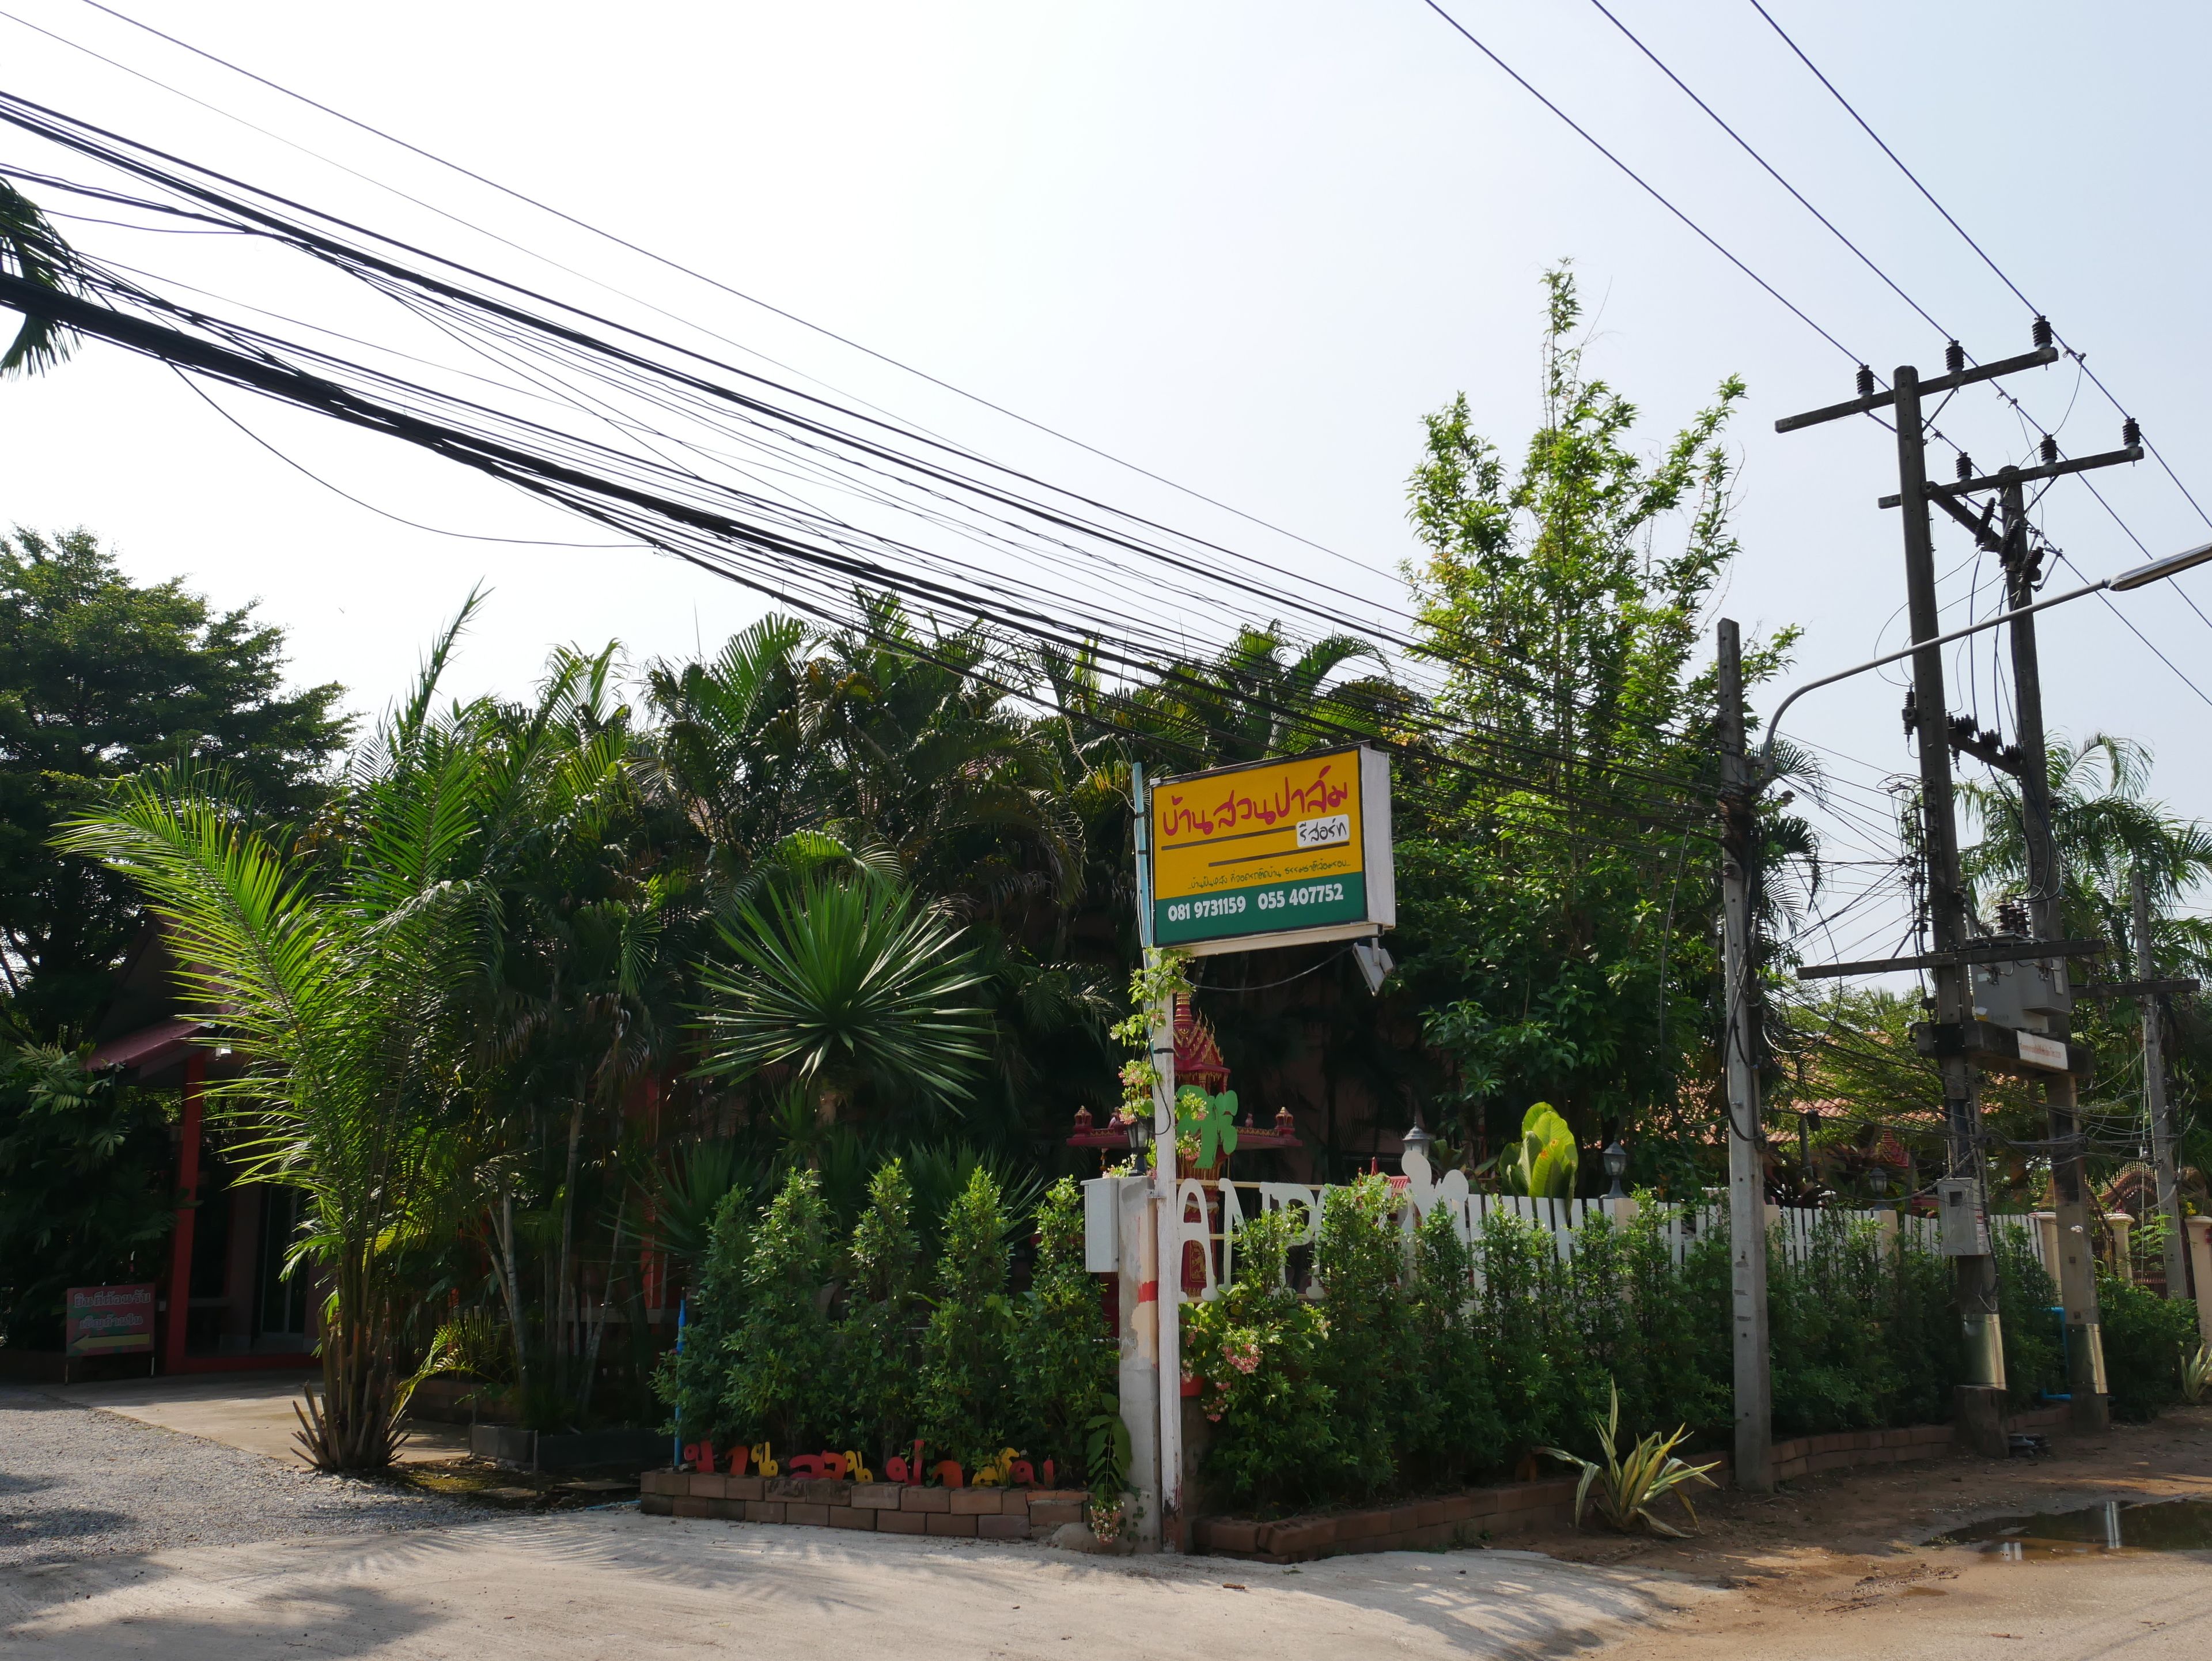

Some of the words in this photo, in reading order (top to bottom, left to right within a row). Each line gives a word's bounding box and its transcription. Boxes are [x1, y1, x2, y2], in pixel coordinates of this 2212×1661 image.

[1162, 765, 1349, 836] บ้านสวนปาล์ม
[1299, 818, 1347, 842] รีสอร์ท
[1168, 902, 1191, 922] 081
[1194, 895, 1247, 919] 9731159
[1257, 890, 1285, 911] 055
[1289, 883, 1344, 906] 407752
